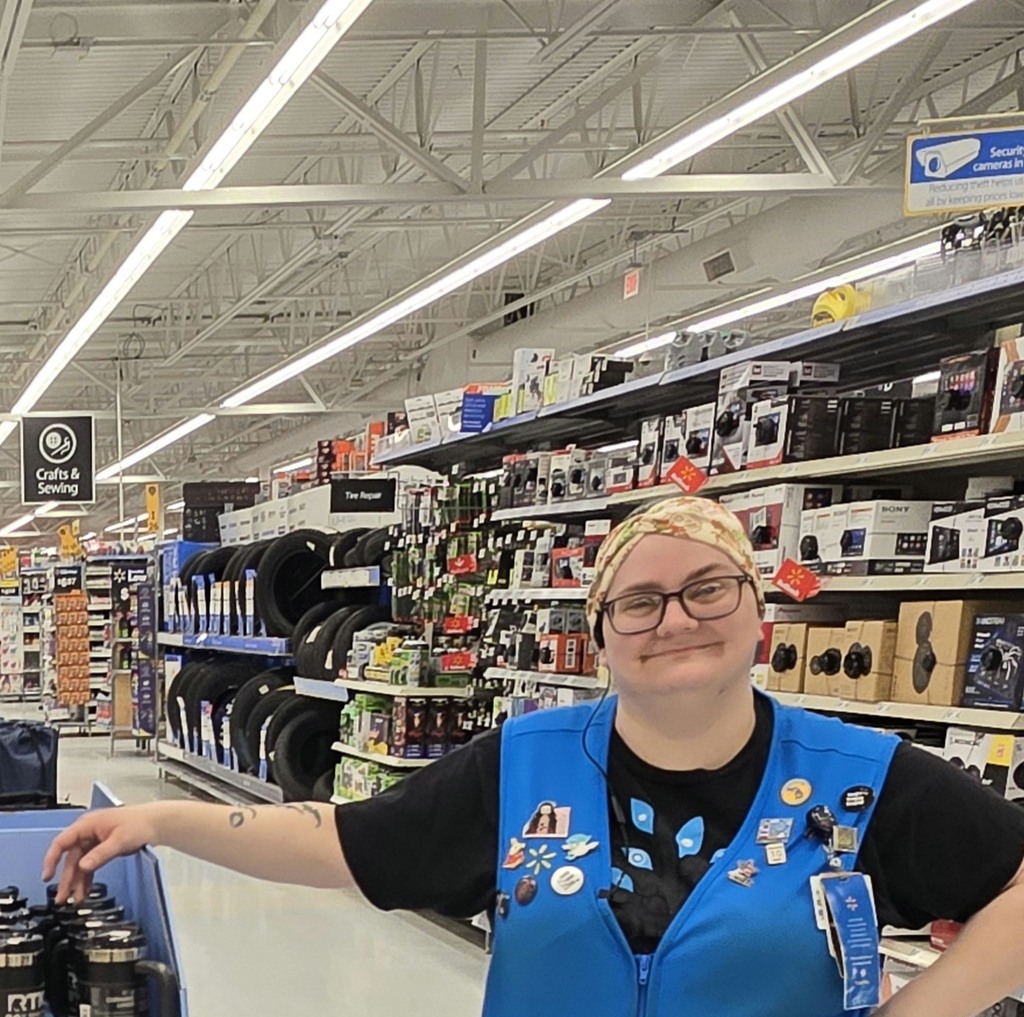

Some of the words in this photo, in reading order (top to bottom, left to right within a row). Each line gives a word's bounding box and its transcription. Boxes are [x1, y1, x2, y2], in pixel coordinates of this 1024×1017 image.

[990, 145, 1024, 158] Securit
[973, 159, 1013, 172] cameras
[1014, 158, 1024, 168] in
[929, 182, 968, 193] Reducing
[949, 193, 981, 205] keeping
[36, 467, 69, 480] Crafts
[70, 467, 80, 480] &
[38, 482, 79, 497] Sewing
